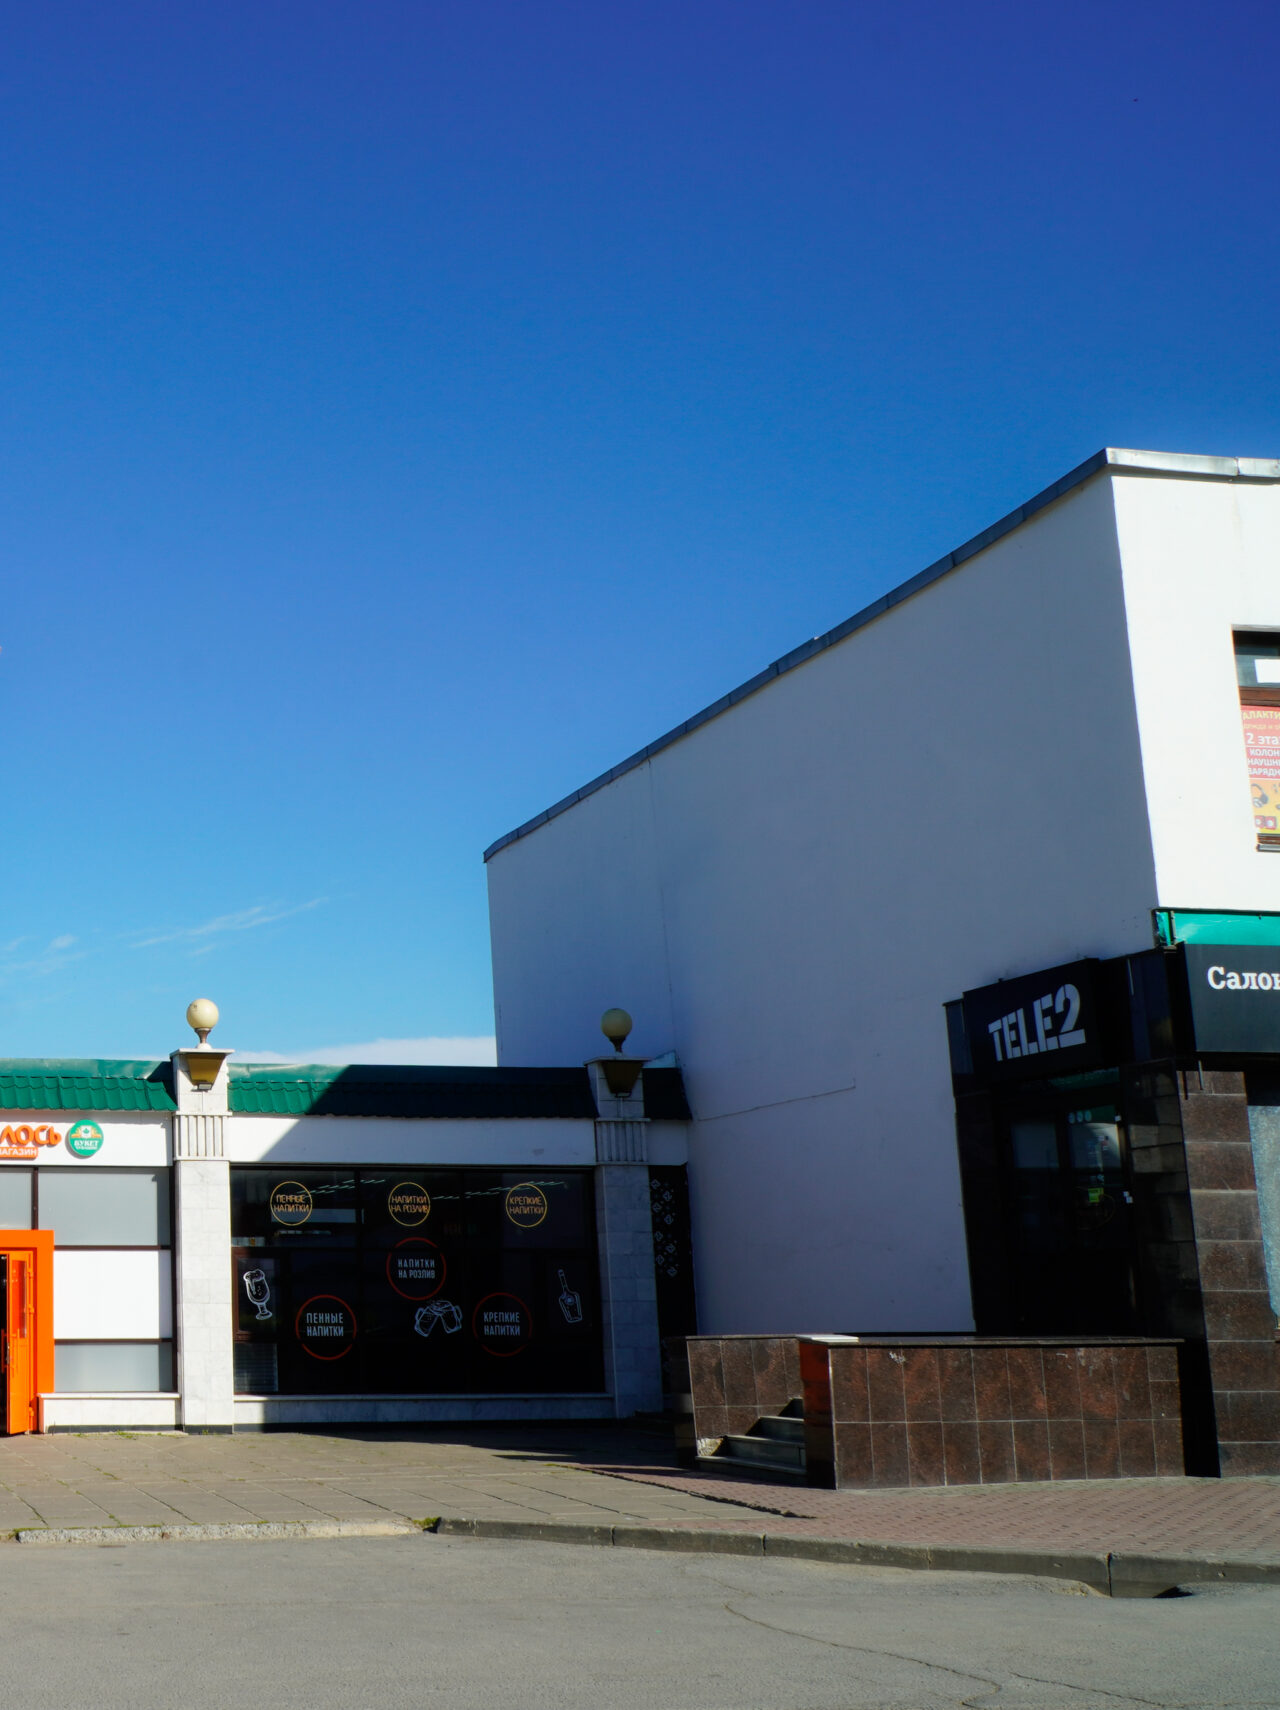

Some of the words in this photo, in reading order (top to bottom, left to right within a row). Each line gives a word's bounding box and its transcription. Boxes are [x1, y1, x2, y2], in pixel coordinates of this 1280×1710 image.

[1246, 732, 1255, 745] 2
[1258, 735, 1280, 746] эта
[988, 983, 1086, 1061] TELE2
[391, 1195, 427, 1204] НАПИТКИ
[510, 1196, 542, 1205] КРЕПКИЕ
[273, 1204, 309, 1213] НАПИТКИ
[391, 1204, 402, 1213] НА
[510, 1206, 544, 1214] НАПИТКИ
[397, 1258, 436, 1268] НАПИТКИ
[398, 1269, 408, 1279] НА
[409, 1269, 436, 1279] РОЗЛИВ
[306, 1312, 344, 1324] ПЕННЫЕ
[483, 1311, 520, 1323] КРЕПКИЕ
[306, 1325, 344, 1337] НАПИТКИ
[483, 1324, 521, 1336] НАПИТКИ
